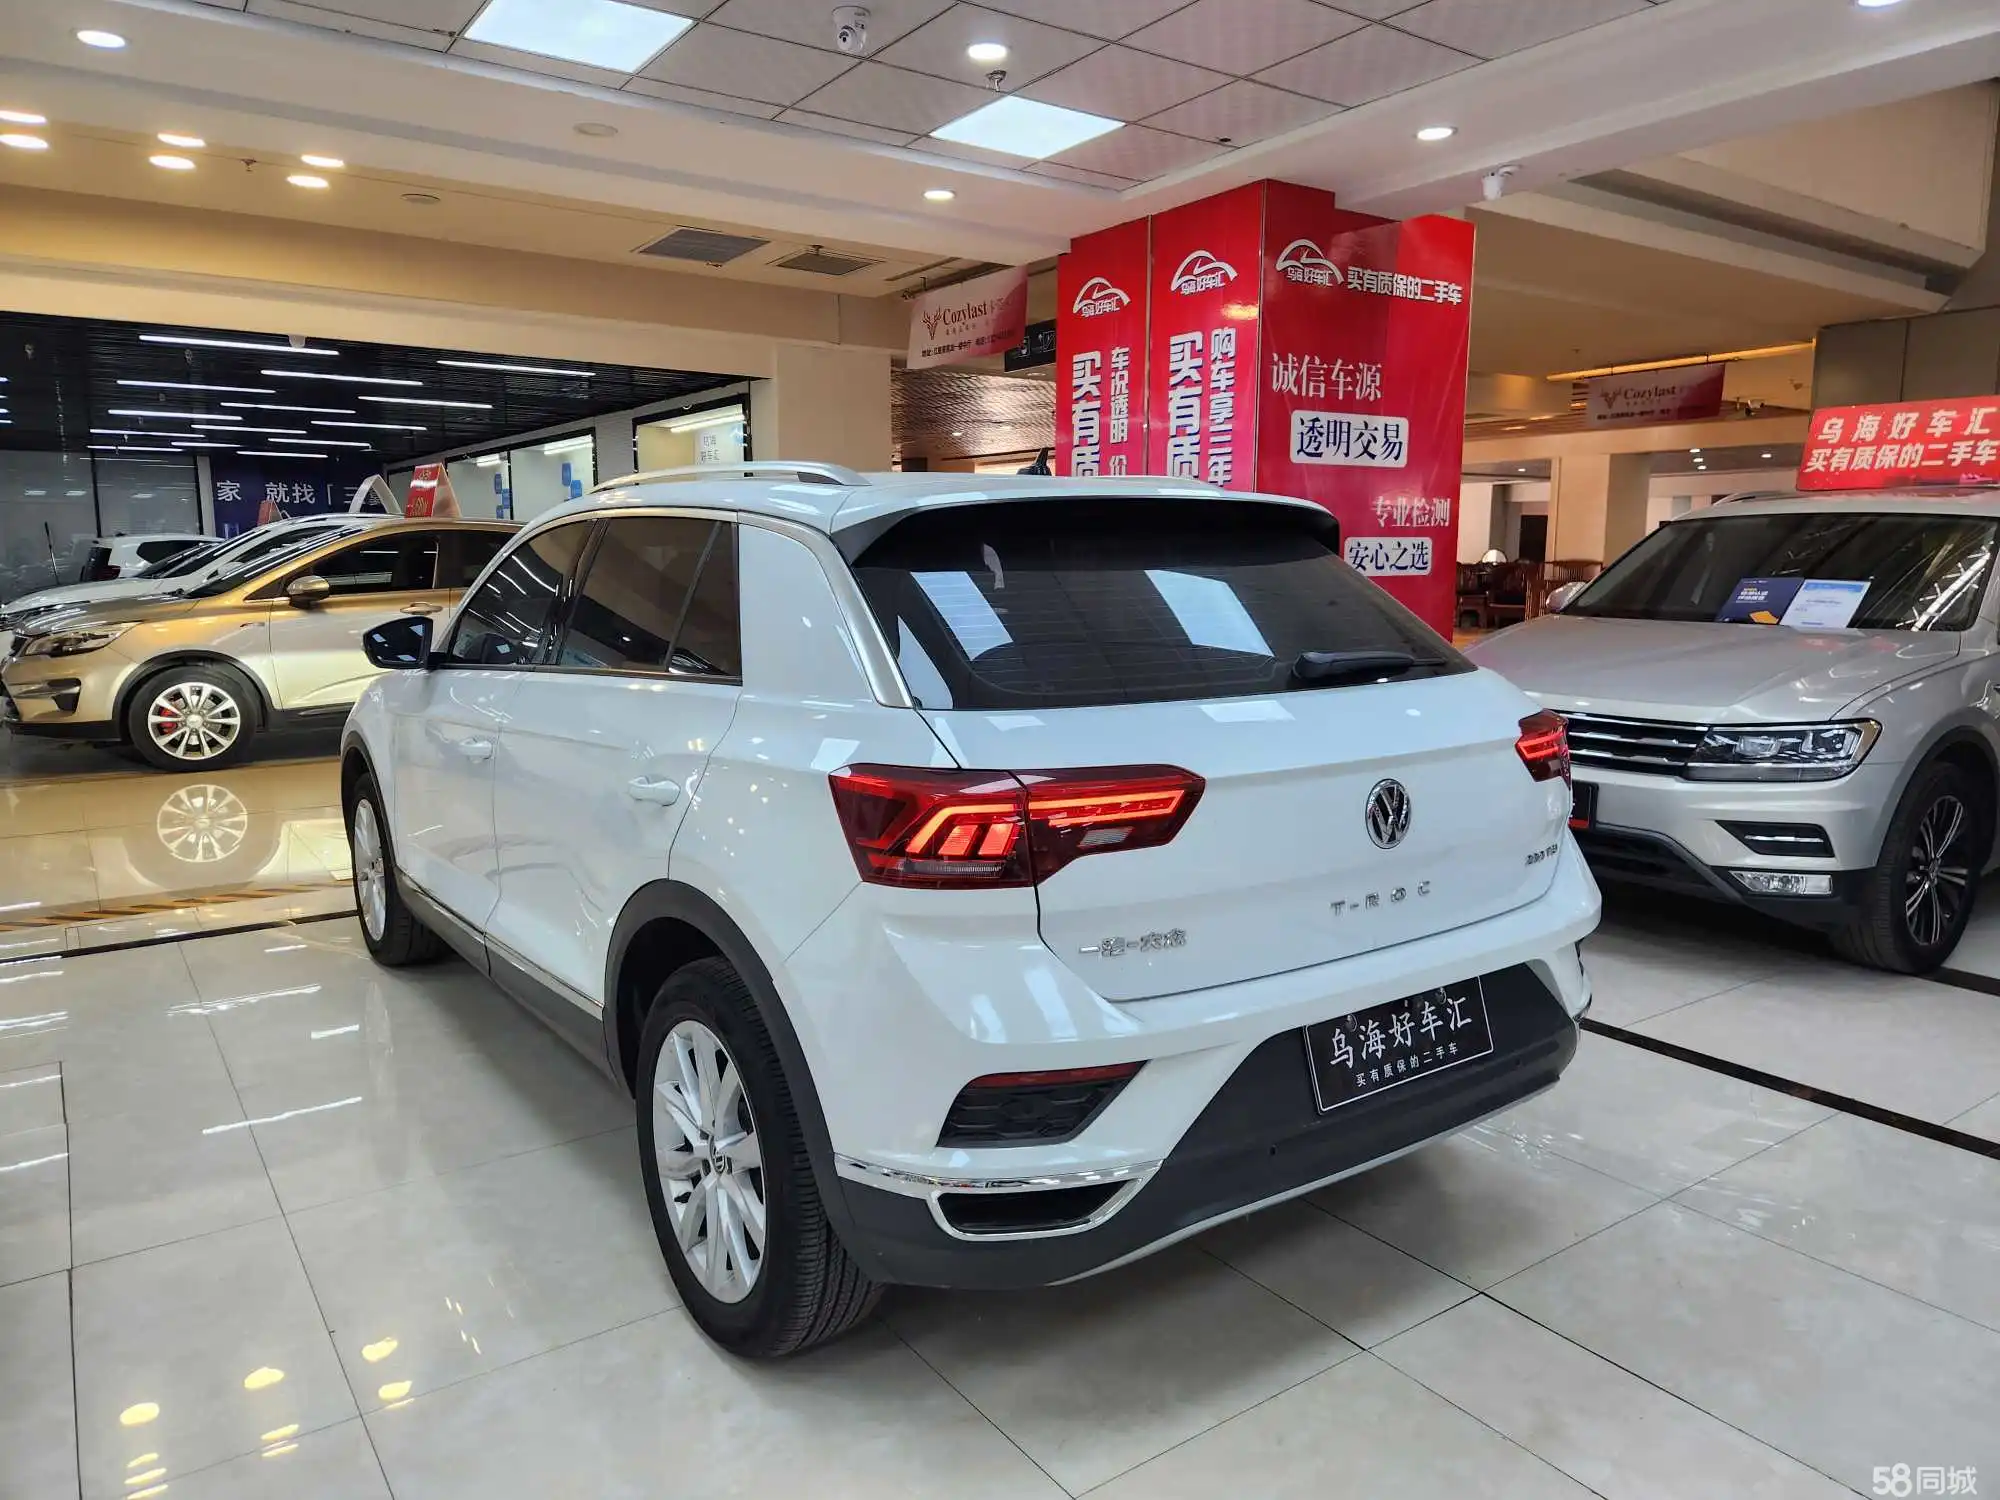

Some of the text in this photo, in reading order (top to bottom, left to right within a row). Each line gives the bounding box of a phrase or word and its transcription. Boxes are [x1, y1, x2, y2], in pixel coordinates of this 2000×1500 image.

[1347, 266, 1463, 306] 买有质保的二手车
[943, 301, 987, 326] Cozylast
[1109, 347, 1131, 444] 车况透明
[1271, 353, 1383, 402] 诚信车源
[1166, 331, 1203, 479] 买有质
[1207, 326, 1237, 487] 购车享三年
[1816, 406, 1998, 444] 乌海好车汇
[1297, 416, 1404, 462] 透明交易
[1803, 438, 2000, 473] 买有质保的二手车
[216, 480, 243, 502] 家
[1370, 496, 1451, 529] 专业检测
[1349, 541, 1430, 571] 安心之选
[1330, 997, 1473, 1069] 乌海好车汇
[1355, 1042, 1459, 1088] 买有质保的二手车
